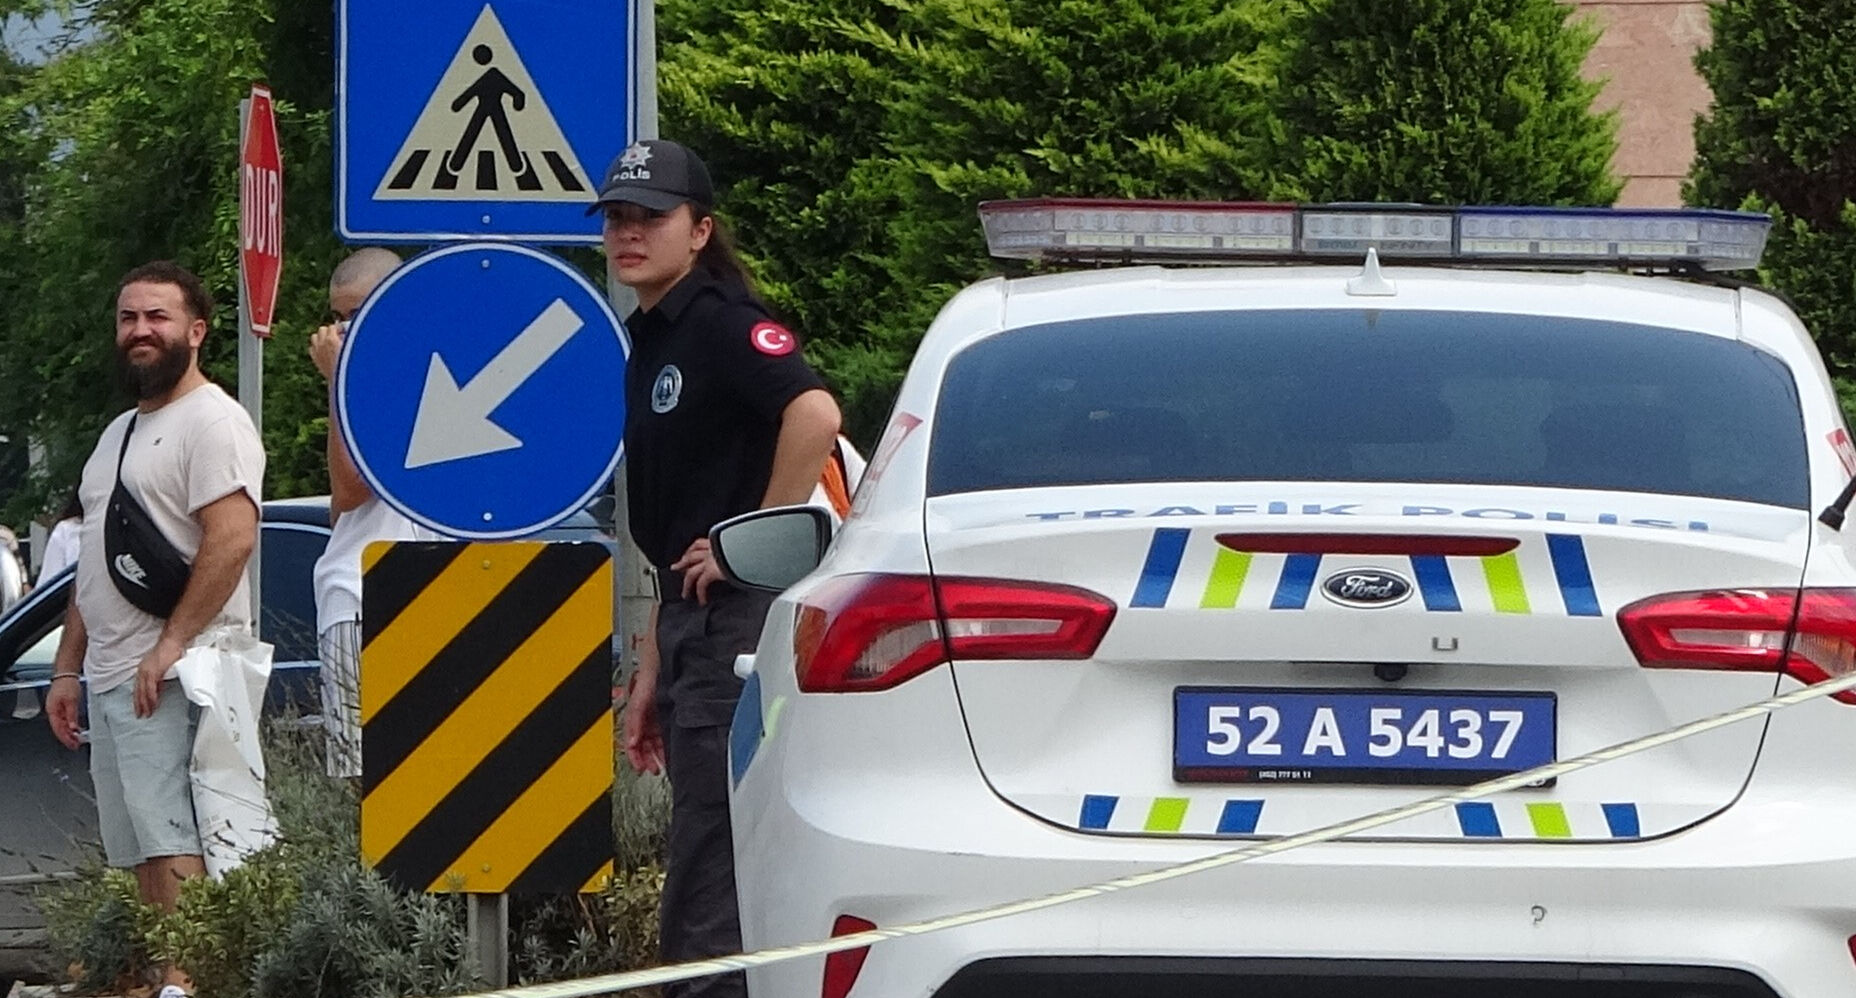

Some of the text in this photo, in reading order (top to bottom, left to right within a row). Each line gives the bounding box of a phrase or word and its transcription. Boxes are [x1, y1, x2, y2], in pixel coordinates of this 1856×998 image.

[245, 163, 278, 258] DUR
[1026, 501, 1364, 522] TRAFİK
[1341, 575, 1393, 598] Ford
[1206, 706, 1524, 759] 52 A 5437
